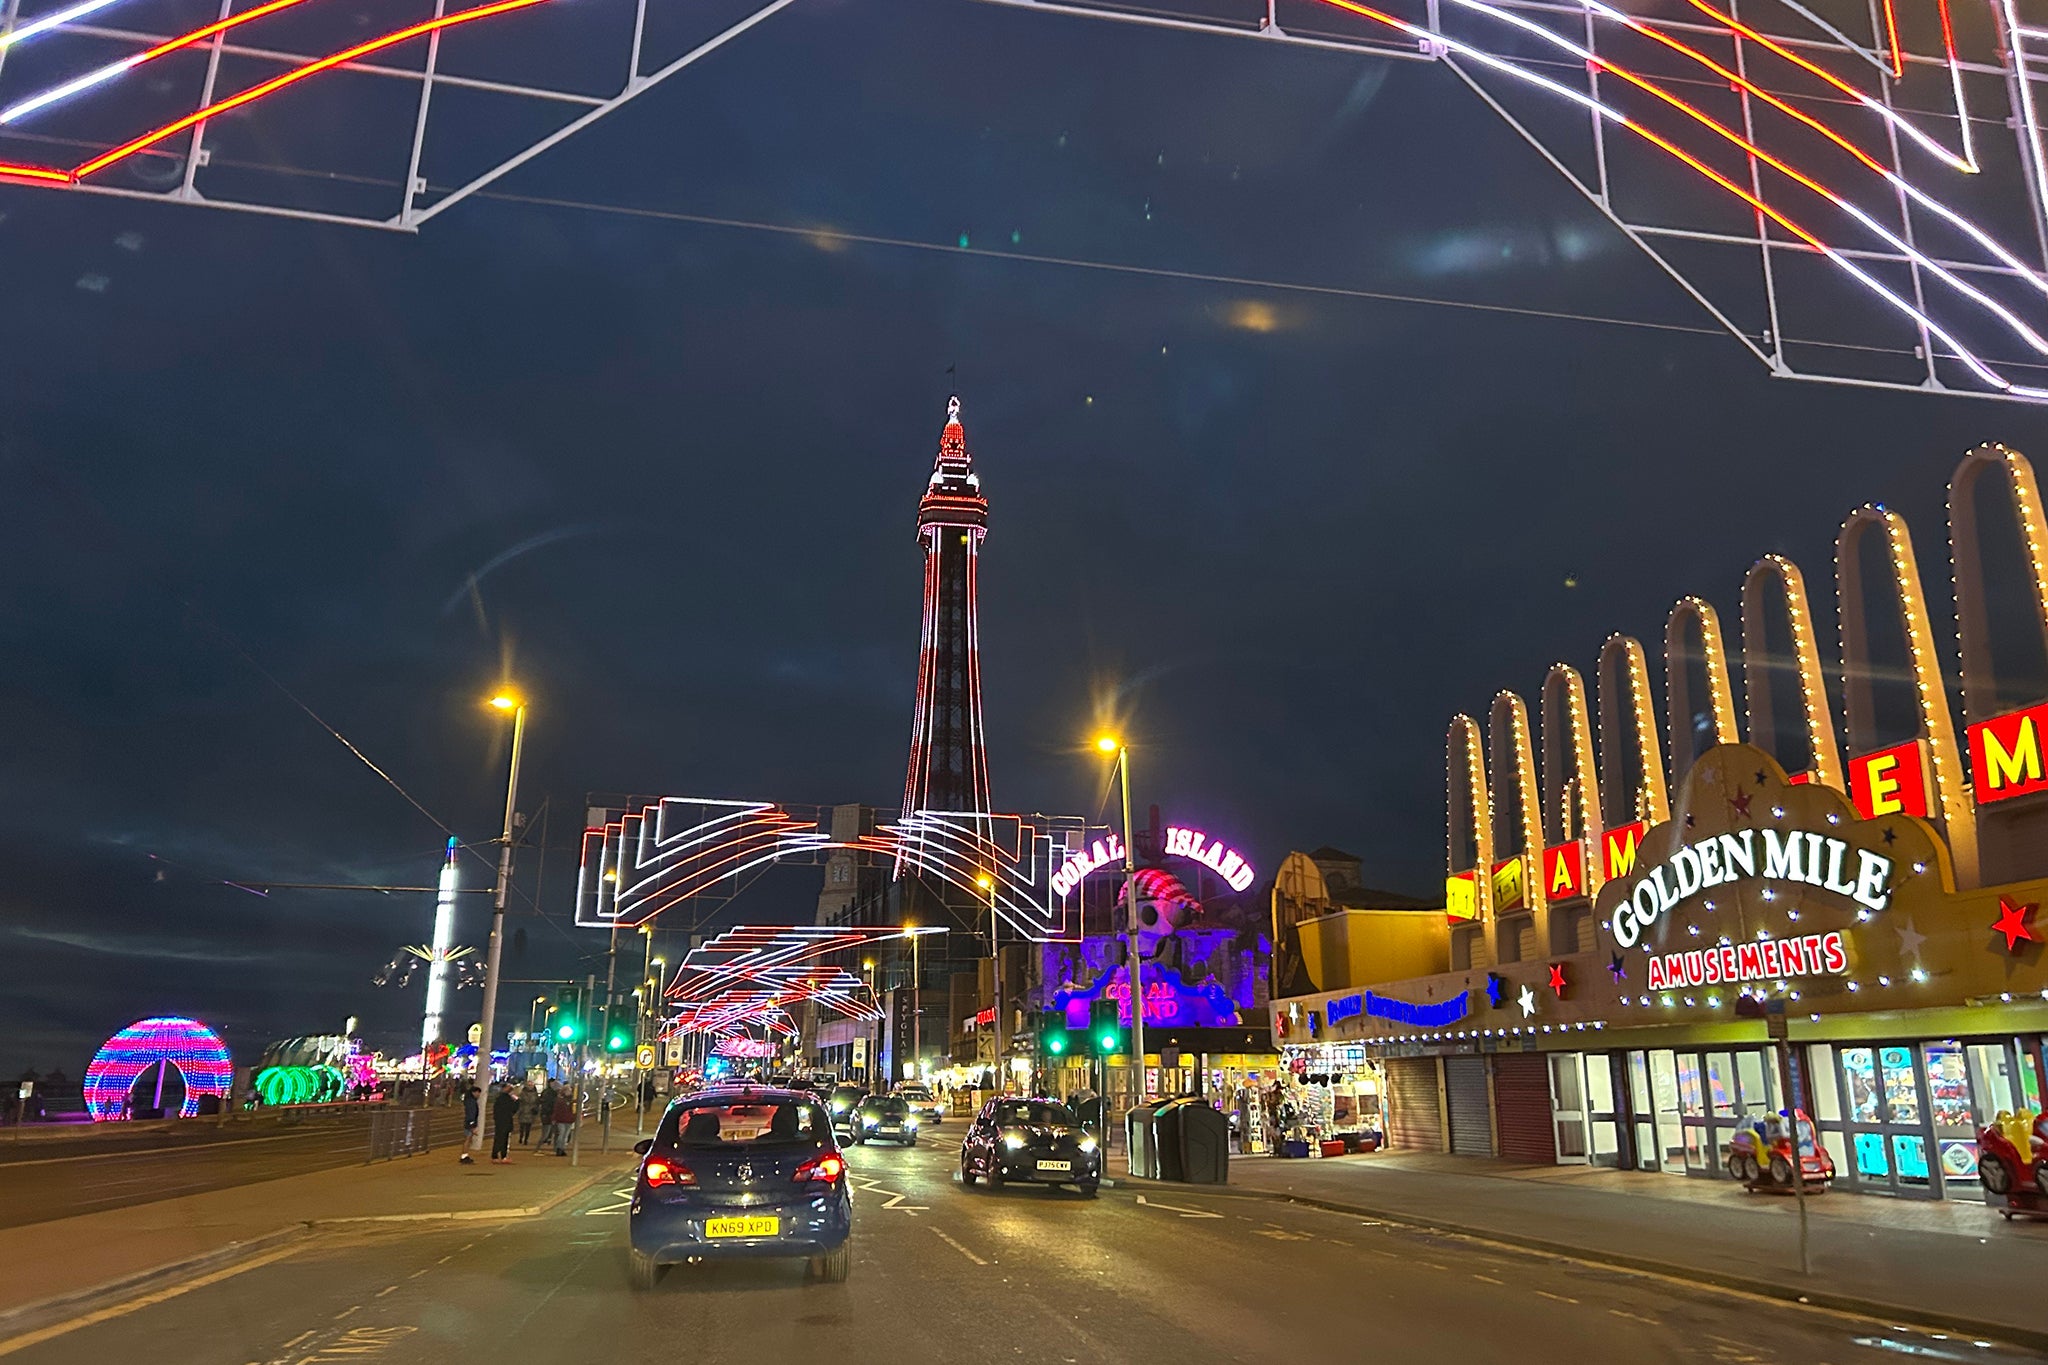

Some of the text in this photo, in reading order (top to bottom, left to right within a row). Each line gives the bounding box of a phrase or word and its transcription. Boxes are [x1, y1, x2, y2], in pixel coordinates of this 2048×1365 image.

[1051, 826, 1256, 896] CORAL ISLAND
[1612, 828, 1891, 948] GOLDEN MILE
[1648, 932, 1848, 991] AMUSEMENTS
[712, 1221, 772, 1234] KN69 XPD
